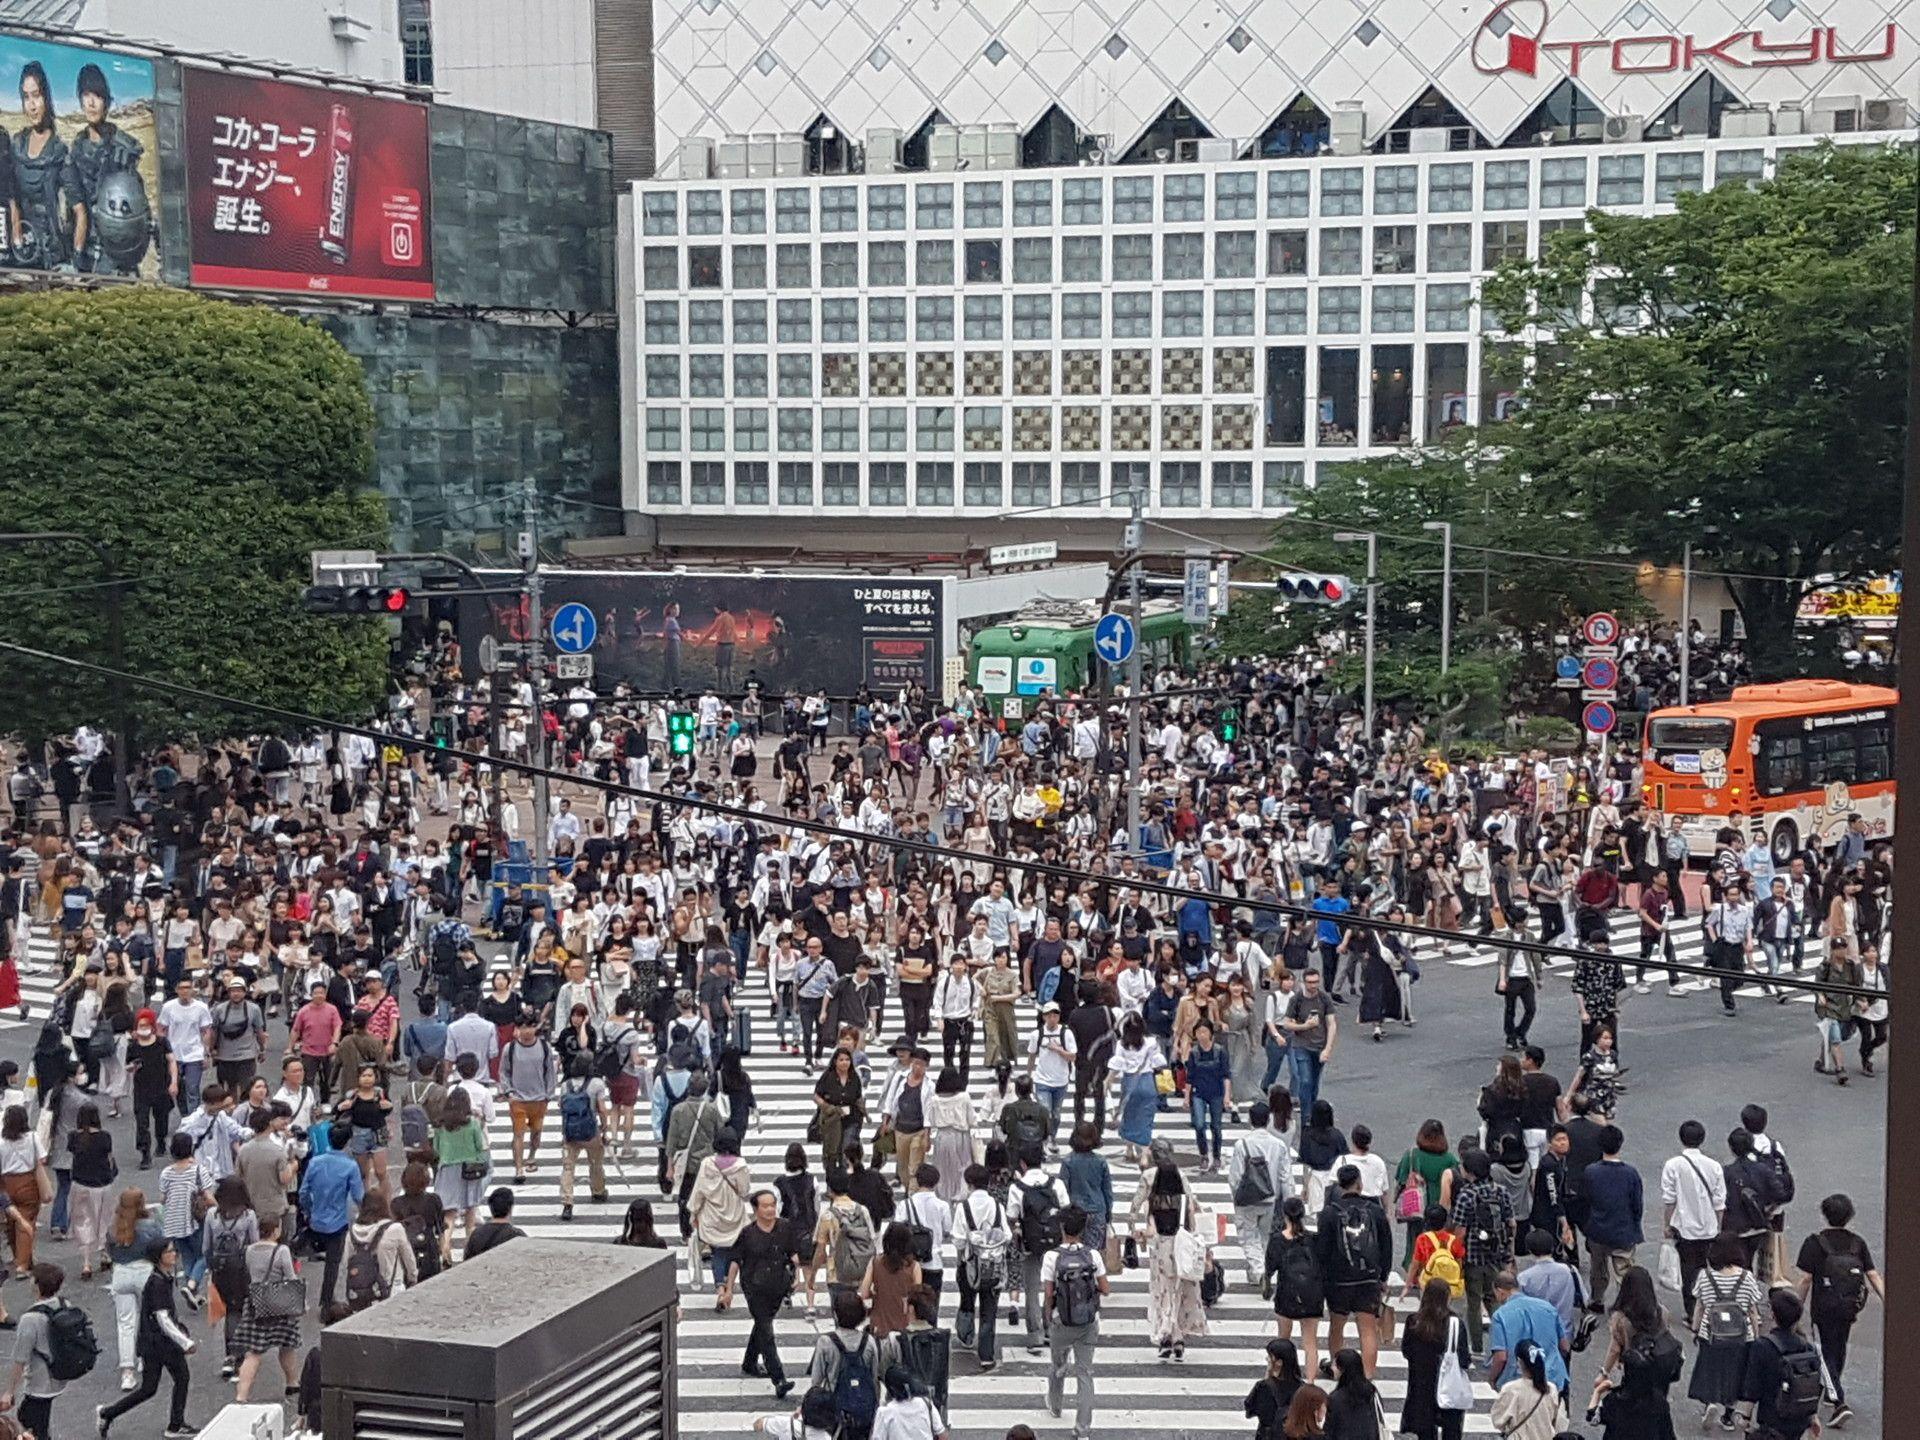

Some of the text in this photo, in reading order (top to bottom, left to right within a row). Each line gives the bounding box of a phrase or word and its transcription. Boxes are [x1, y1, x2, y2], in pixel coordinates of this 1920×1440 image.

[1542, 23, 1896, 77] TOKYU
[212, 115, 317, 158] コカ・コーラ
[211, 157, 302, 197] エナジー、
[329, 149, 350, 239] ENERGY
[213, 194, 271, 235] 誕生。
